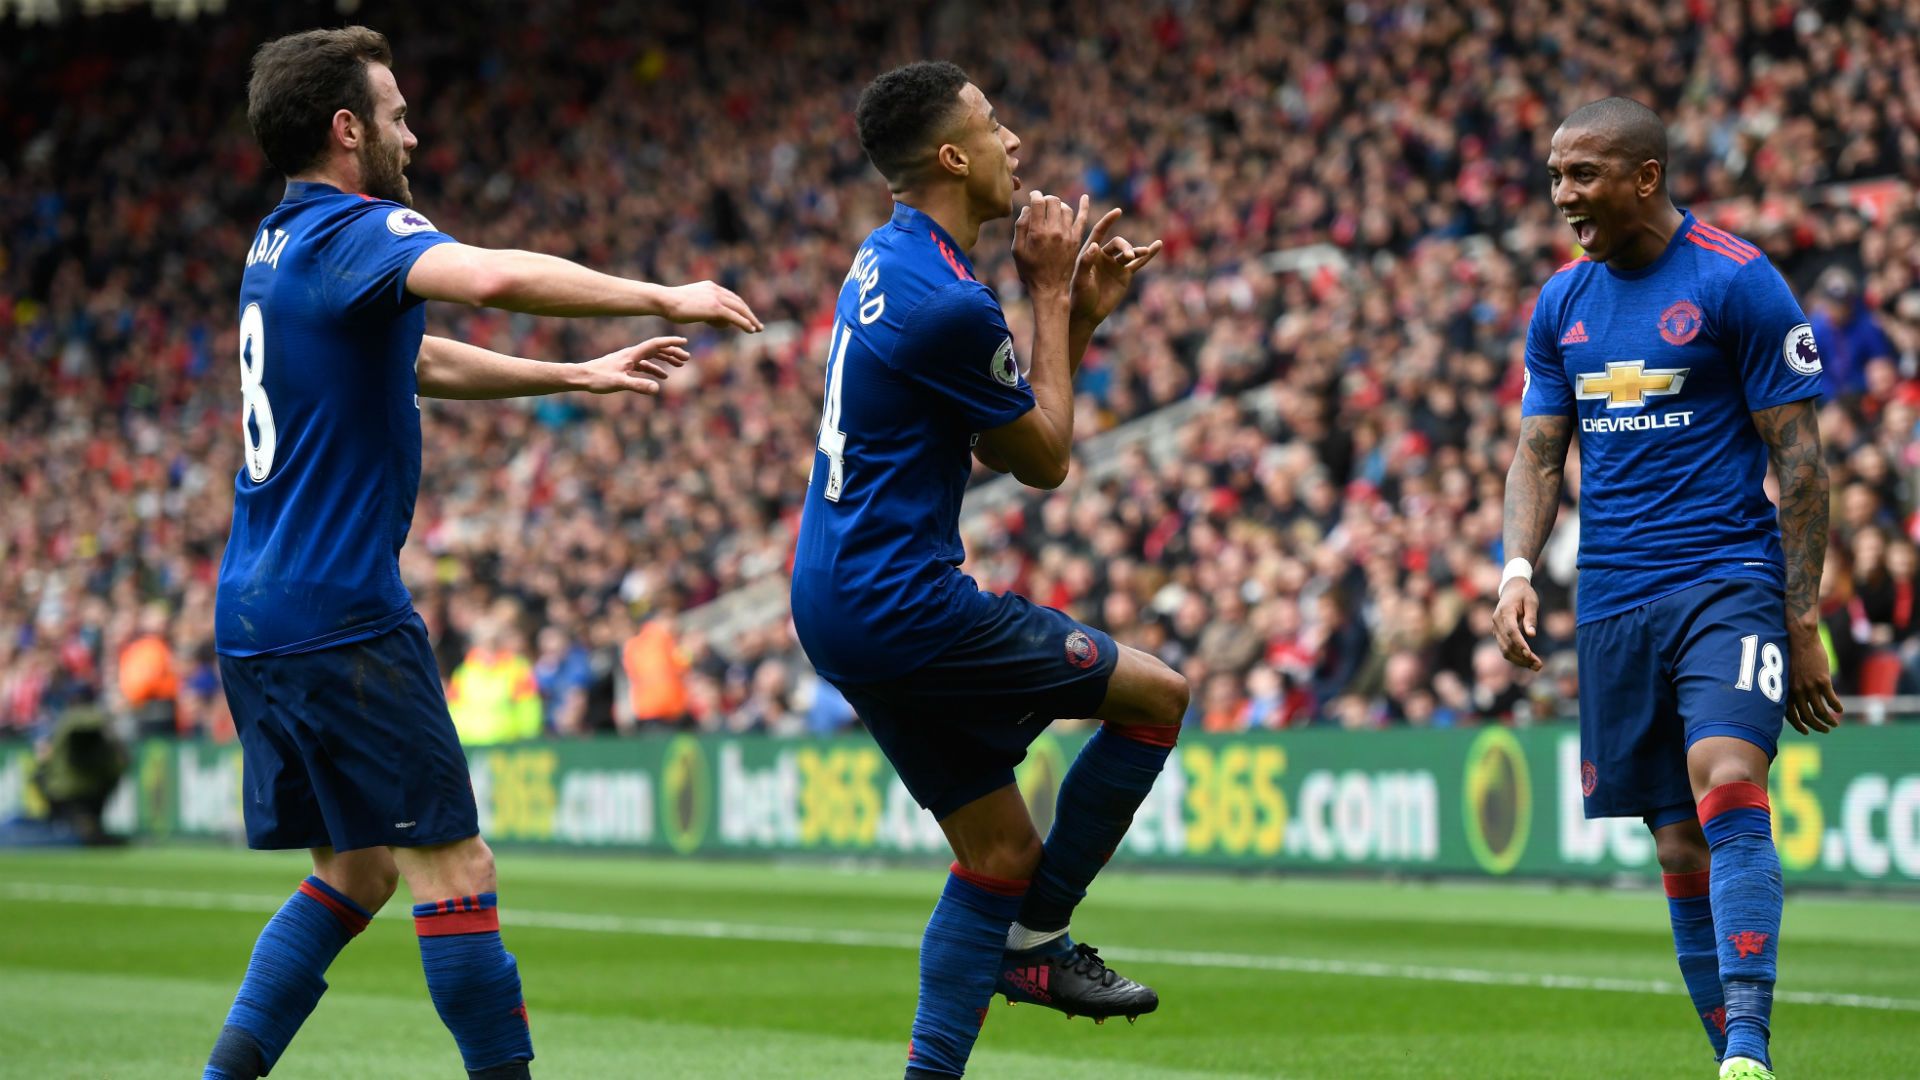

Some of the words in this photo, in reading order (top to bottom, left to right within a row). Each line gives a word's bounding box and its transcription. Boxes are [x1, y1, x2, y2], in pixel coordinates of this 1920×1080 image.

[845, 246, 885, 325] NGARD
[1561, 335, 1589, 345] adidas
[240, 303, 276, 483] 8
[1582, 411, 1694, 433] CHEVROLET
[1735, 634, 1784, 703] 18
